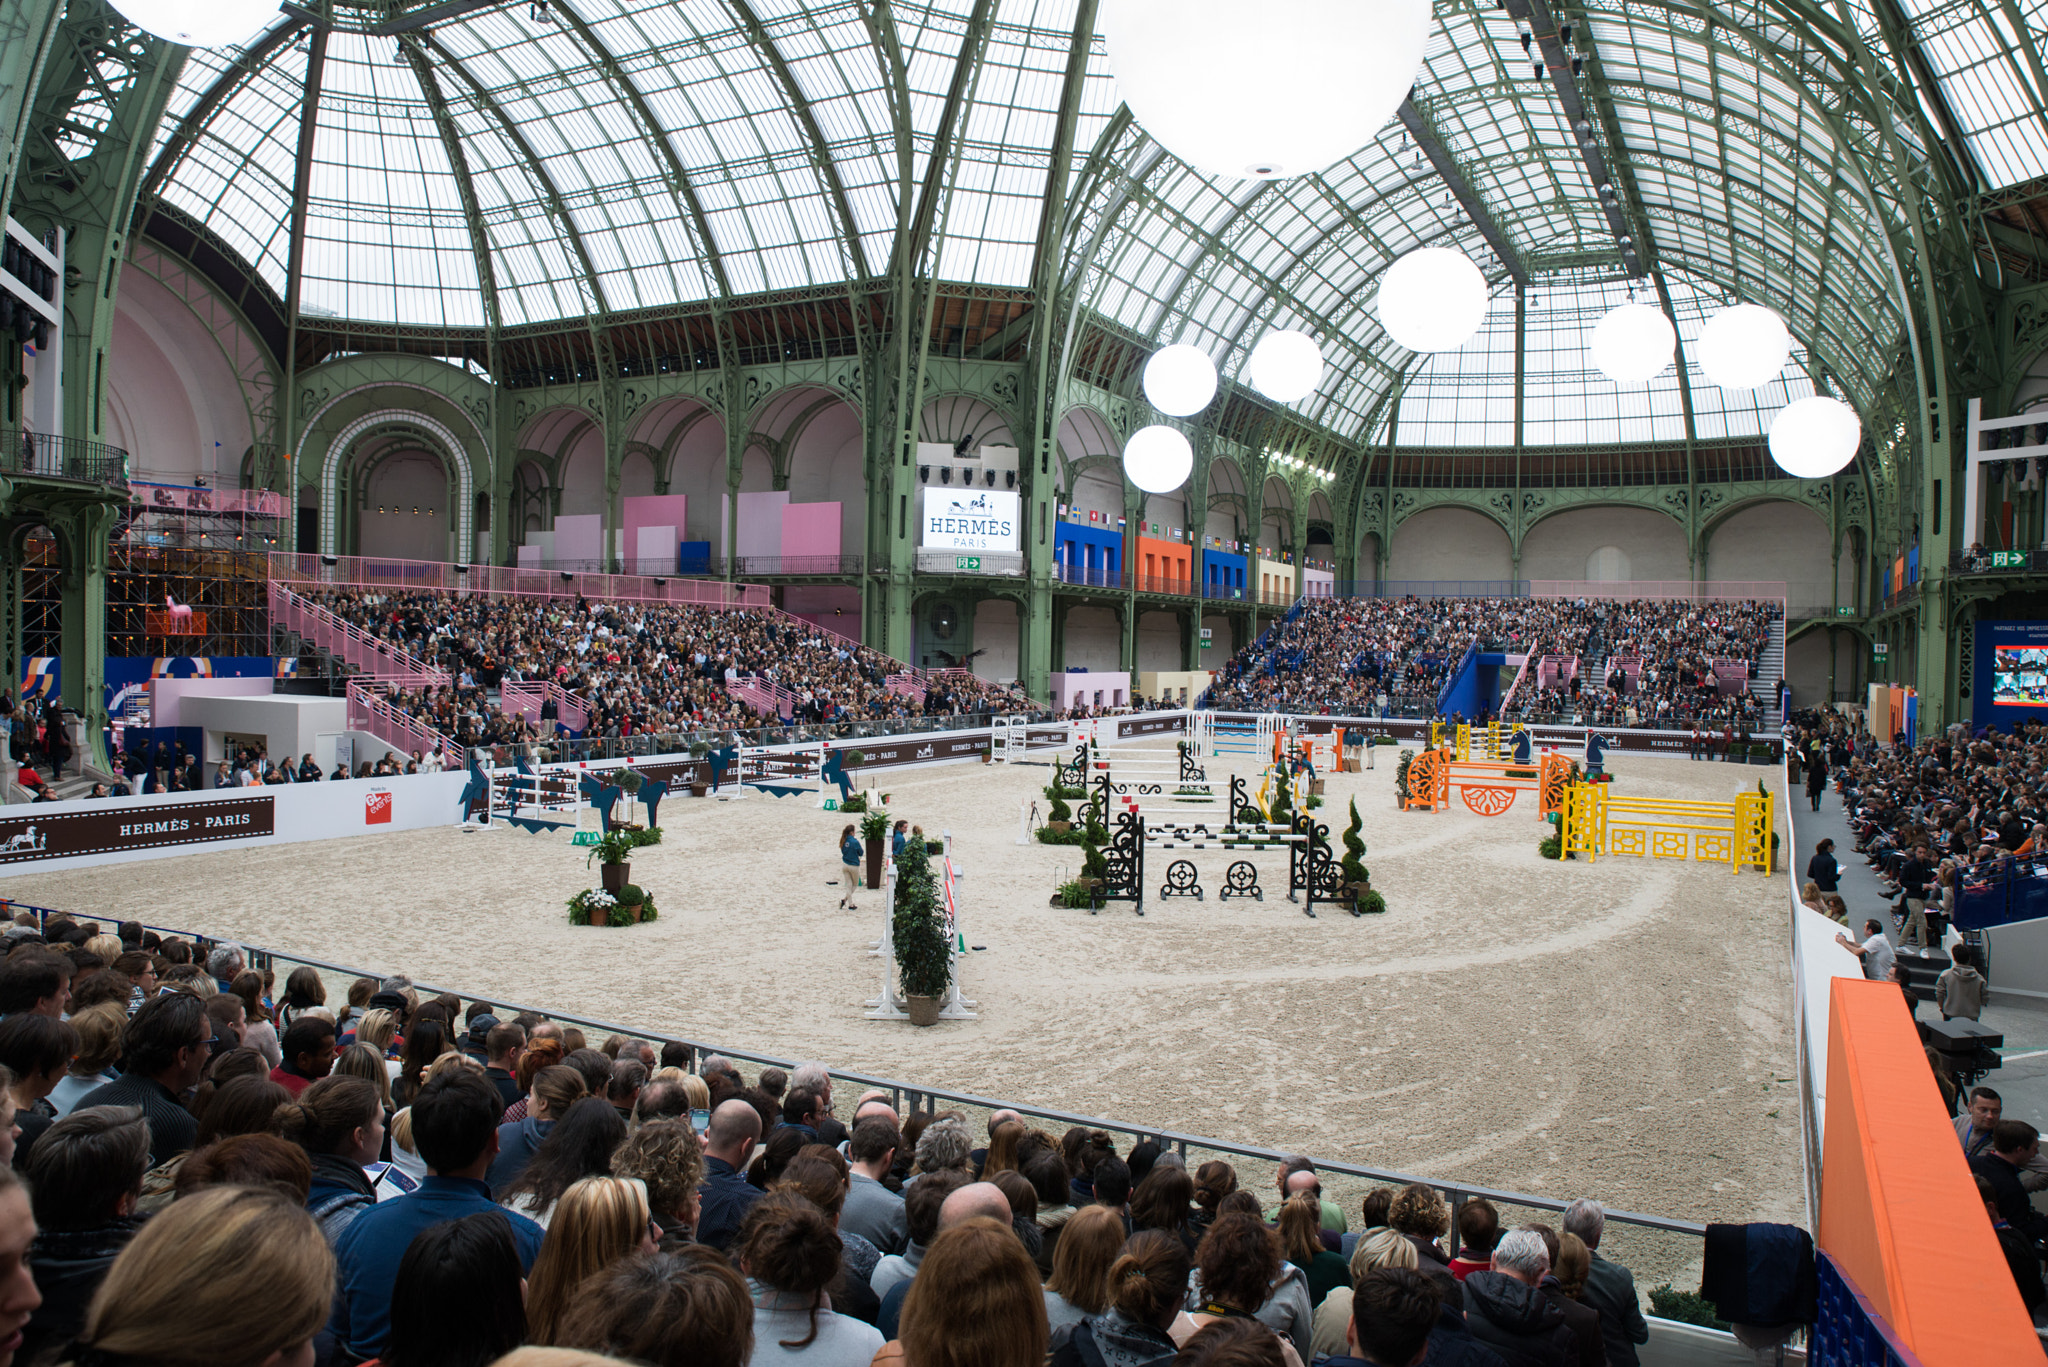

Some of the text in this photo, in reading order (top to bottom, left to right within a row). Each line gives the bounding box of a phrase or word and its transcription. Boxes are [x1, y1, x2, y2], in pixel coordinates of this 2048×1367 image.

[930, 518, 1011, 536] HERMÈS
[953, 537, 987, 548] PARIS
[880, 751, 898, 760] PARIS
[366, 793, 382, 807] GL
[370, 793, 393, 814] events
[119, 818, 190, 836] HERMÈS
[204, 813, 251, 828] PARIS
[1207, 1304, 1225, 1314] Nikon
